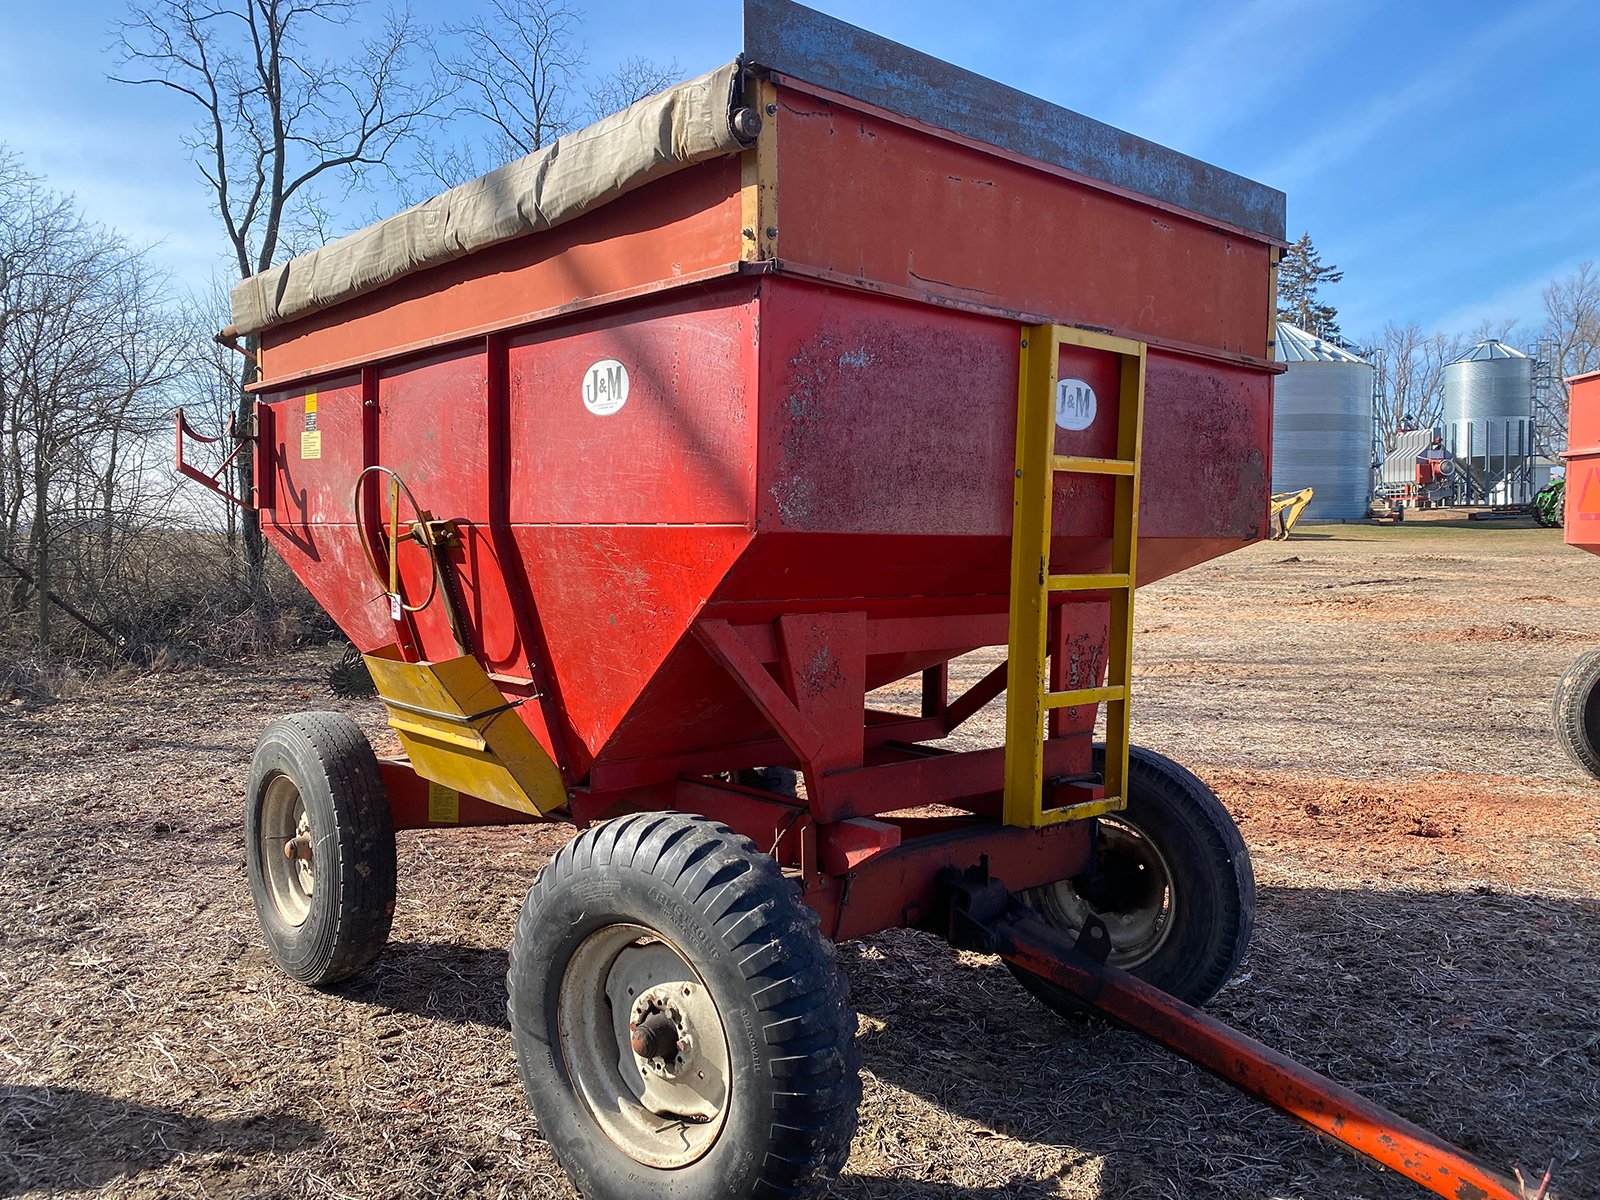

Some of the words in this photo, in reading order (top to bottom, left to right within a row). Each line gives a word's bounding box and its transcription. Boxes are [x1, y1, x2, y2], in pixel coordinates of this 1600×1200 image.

[586, 366, 622, 403] J&M
[1056, 384, 1091, 418] J&M
[648, 886, 721, 961] ARMSTRONG
